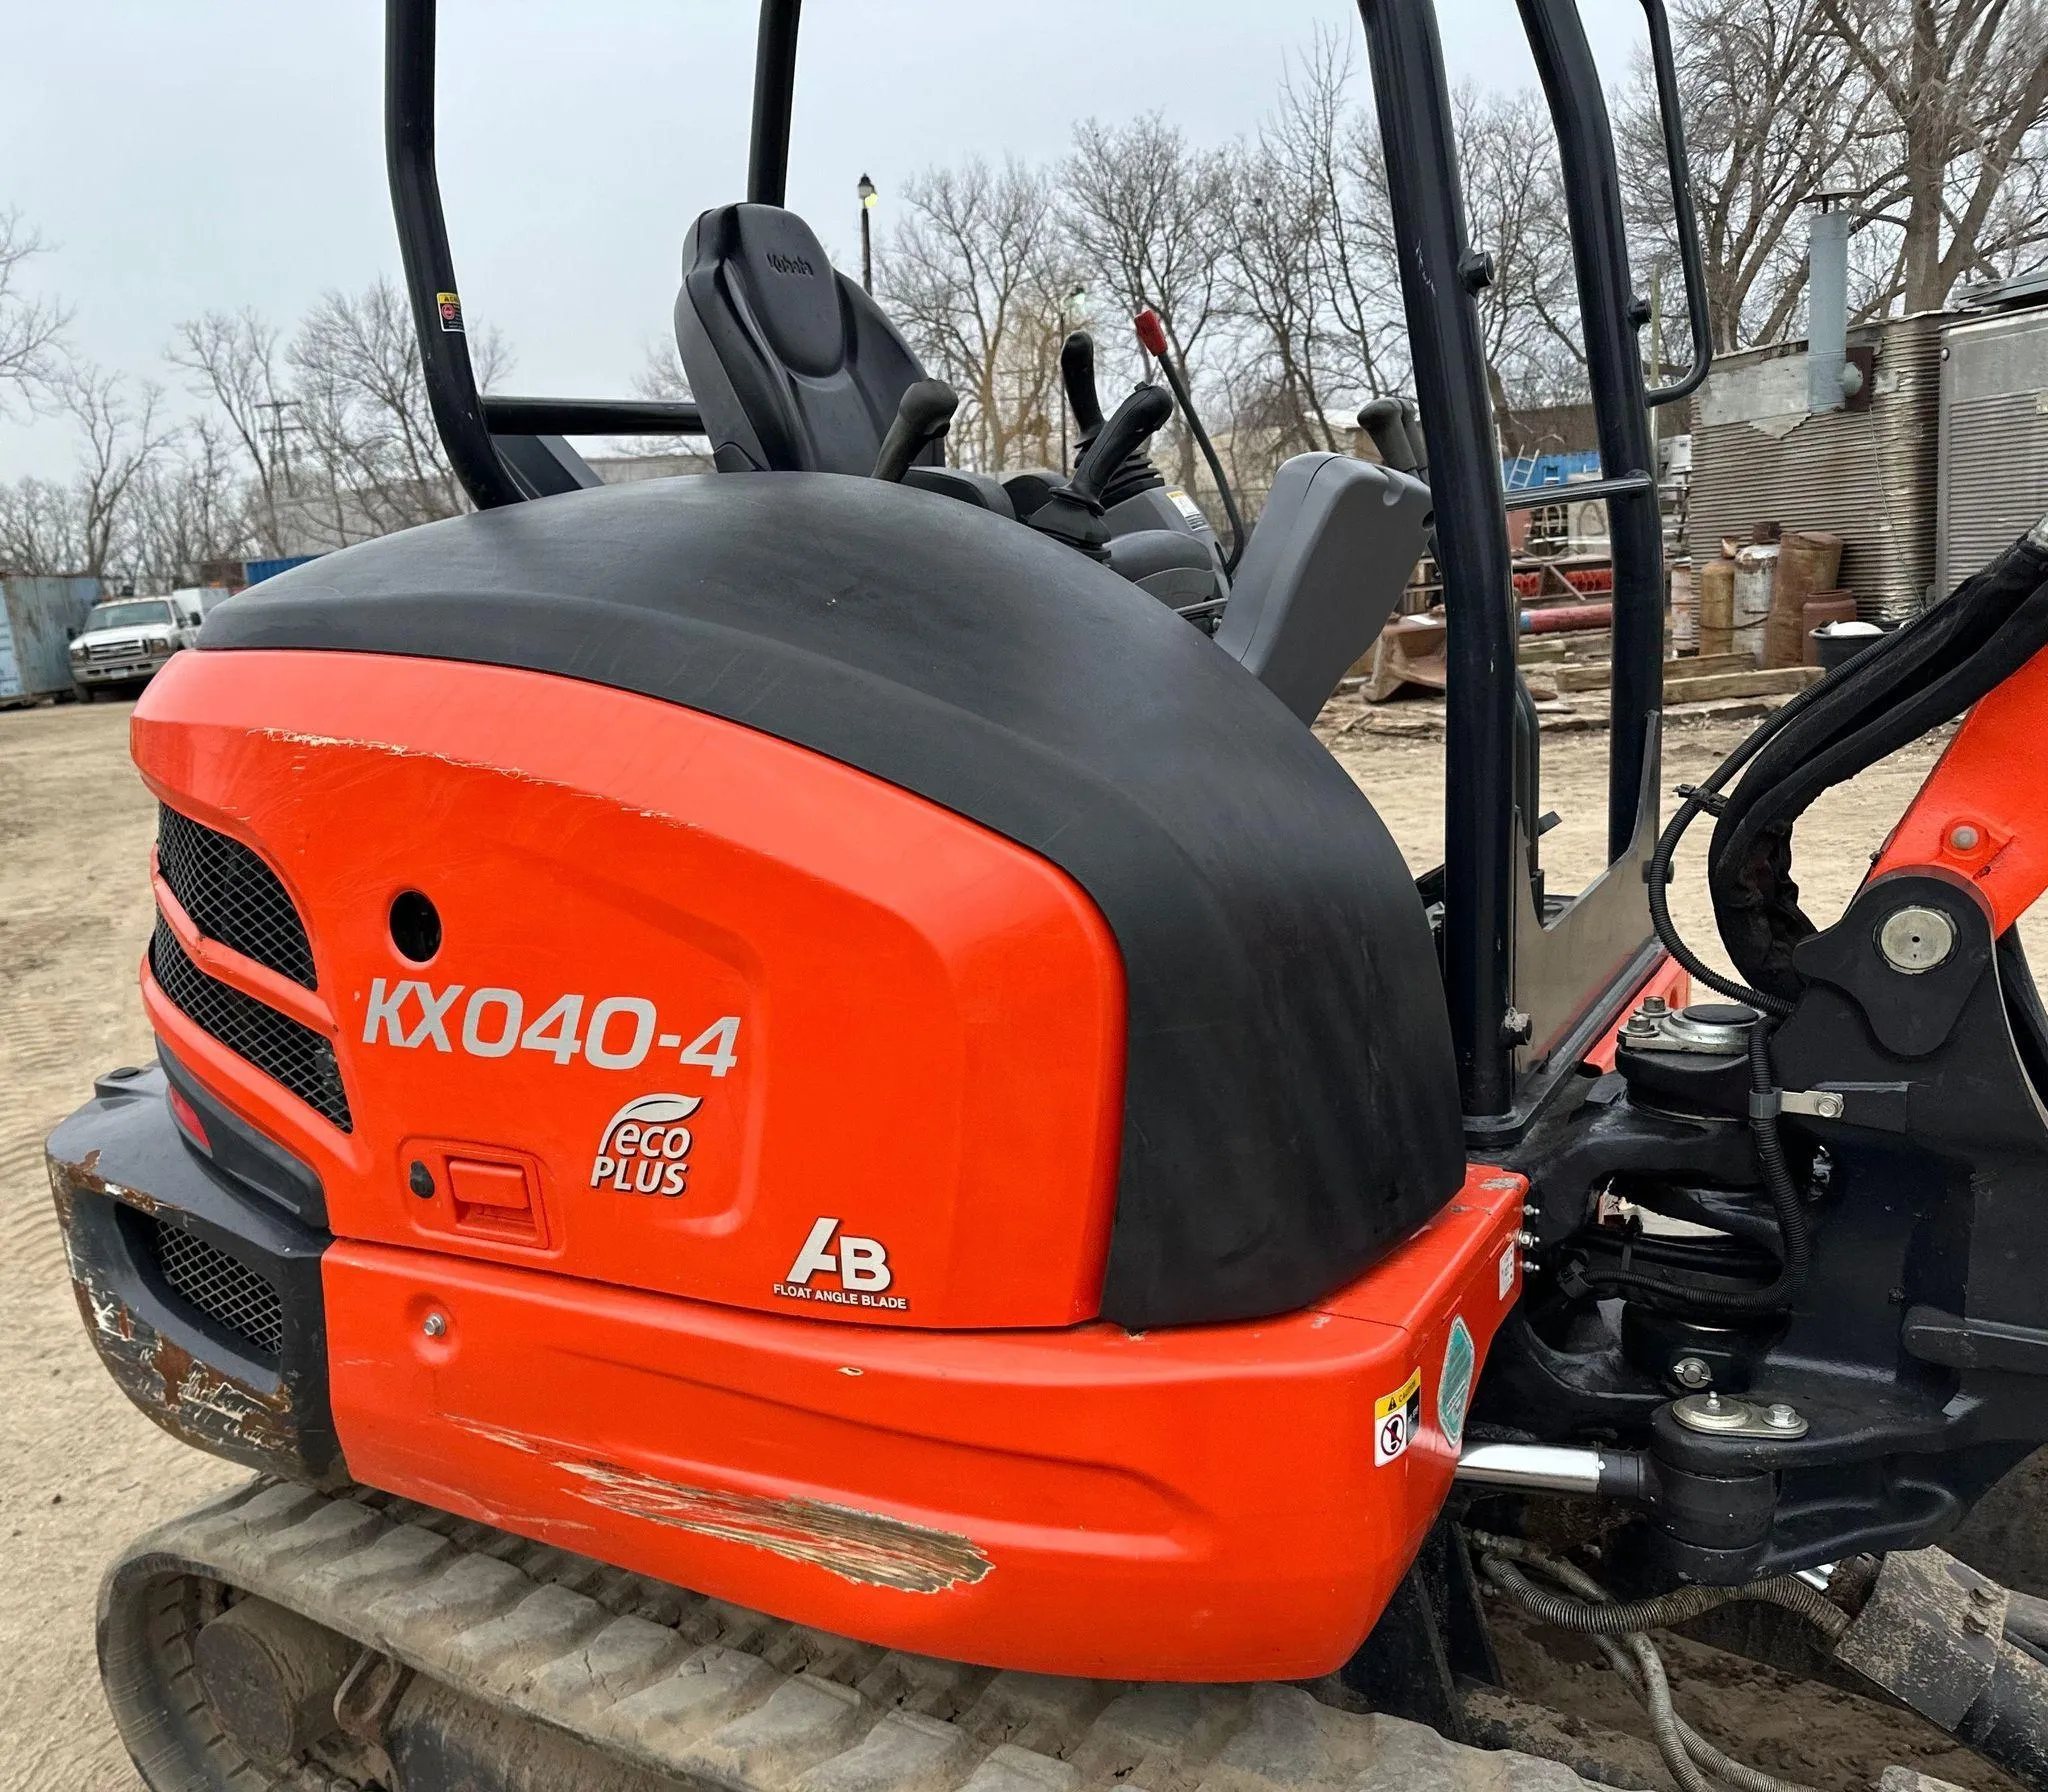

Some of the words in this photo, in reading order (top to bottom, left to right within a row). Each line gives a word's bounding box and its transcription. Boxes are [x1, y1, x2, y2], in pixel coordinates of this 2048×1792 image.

[362, 978, 741, 1077] KX040-4
[615, 1123, 692, 1159] eco
[590, 1156, 688, 1195] PLUS
[773, 1284, 812, 1299] FLOAT
[815, 1290, 858, 1305] ANGLE
[862, 1295, 907, 1309] BLADE
